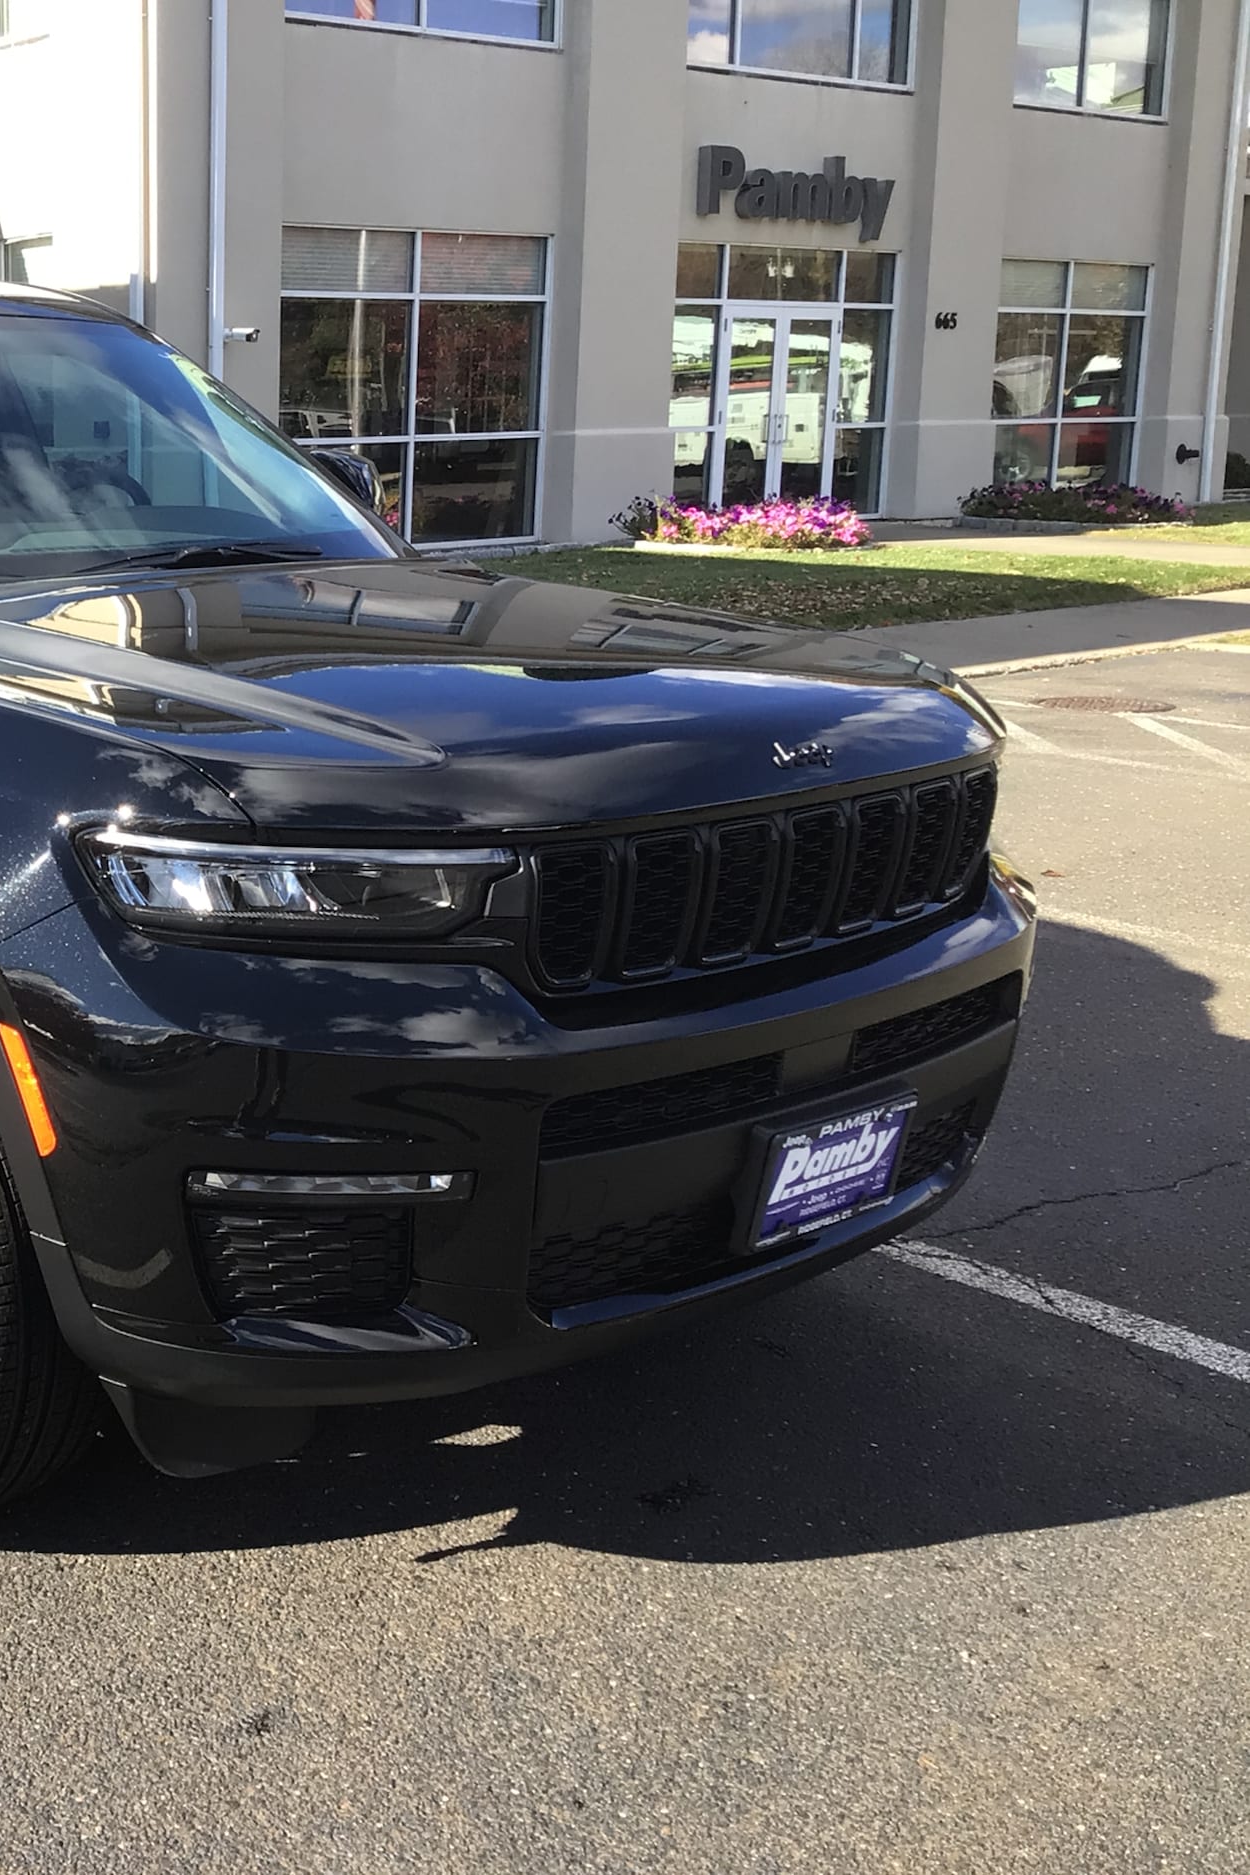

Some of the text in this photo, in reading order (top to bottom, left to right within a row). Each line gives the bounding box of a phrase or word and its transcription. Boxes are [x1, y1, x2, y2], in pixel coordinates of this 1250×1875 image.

[696, 144, 896, 243] Pamby
[935, 312, 958, 330] 665
[772, 741, 834, 769] Jeep
[818, 1107, 885, 1139] PAMBY
[767, 1122, 900, 1206] Pamby
